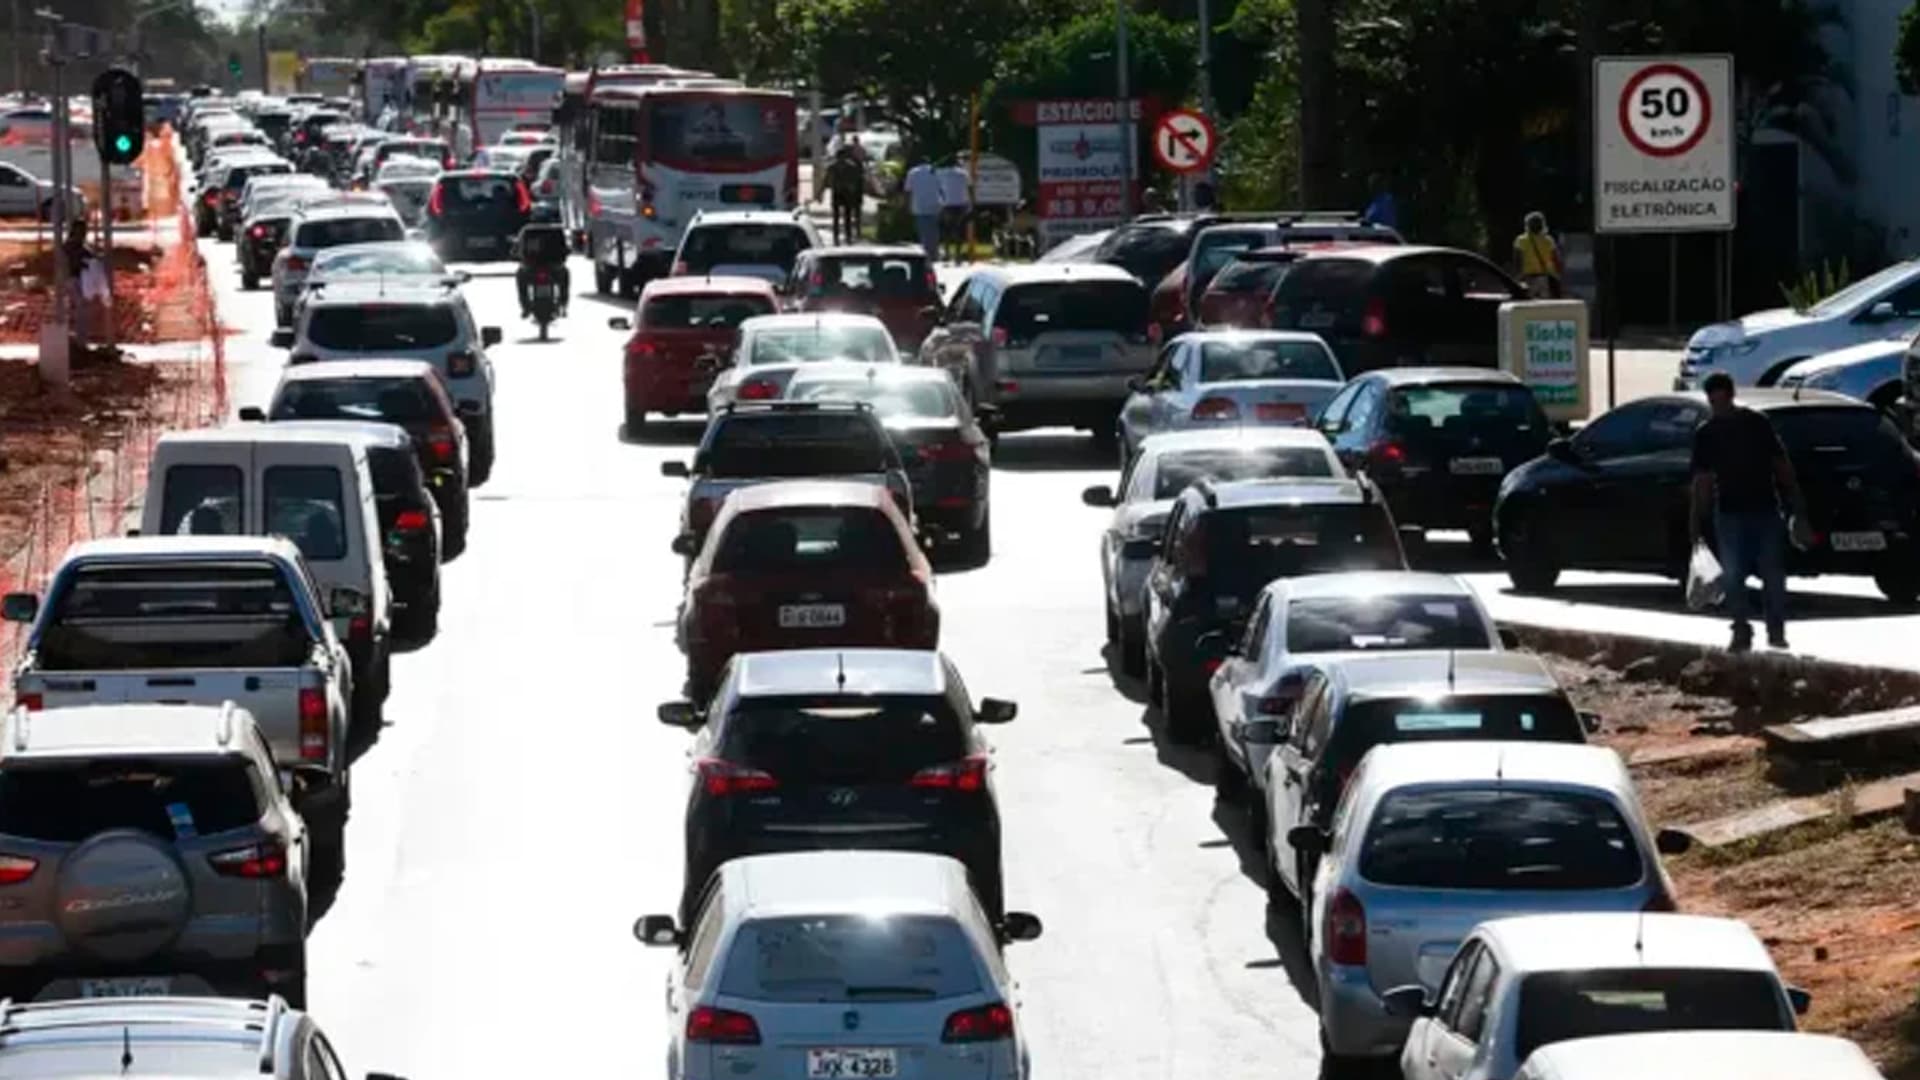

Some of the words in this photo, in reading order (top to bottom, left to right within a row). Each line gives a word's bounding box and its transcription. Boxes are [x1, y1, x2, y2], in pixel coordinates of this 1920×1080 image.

[1038, 100, 1142, 121] ESTACIOE
[1640, 87, 1689, 119] 50
[1650, 126, 1685, 138] km/h
[1611, 200, 1717, 218] ELETRÔNICA
